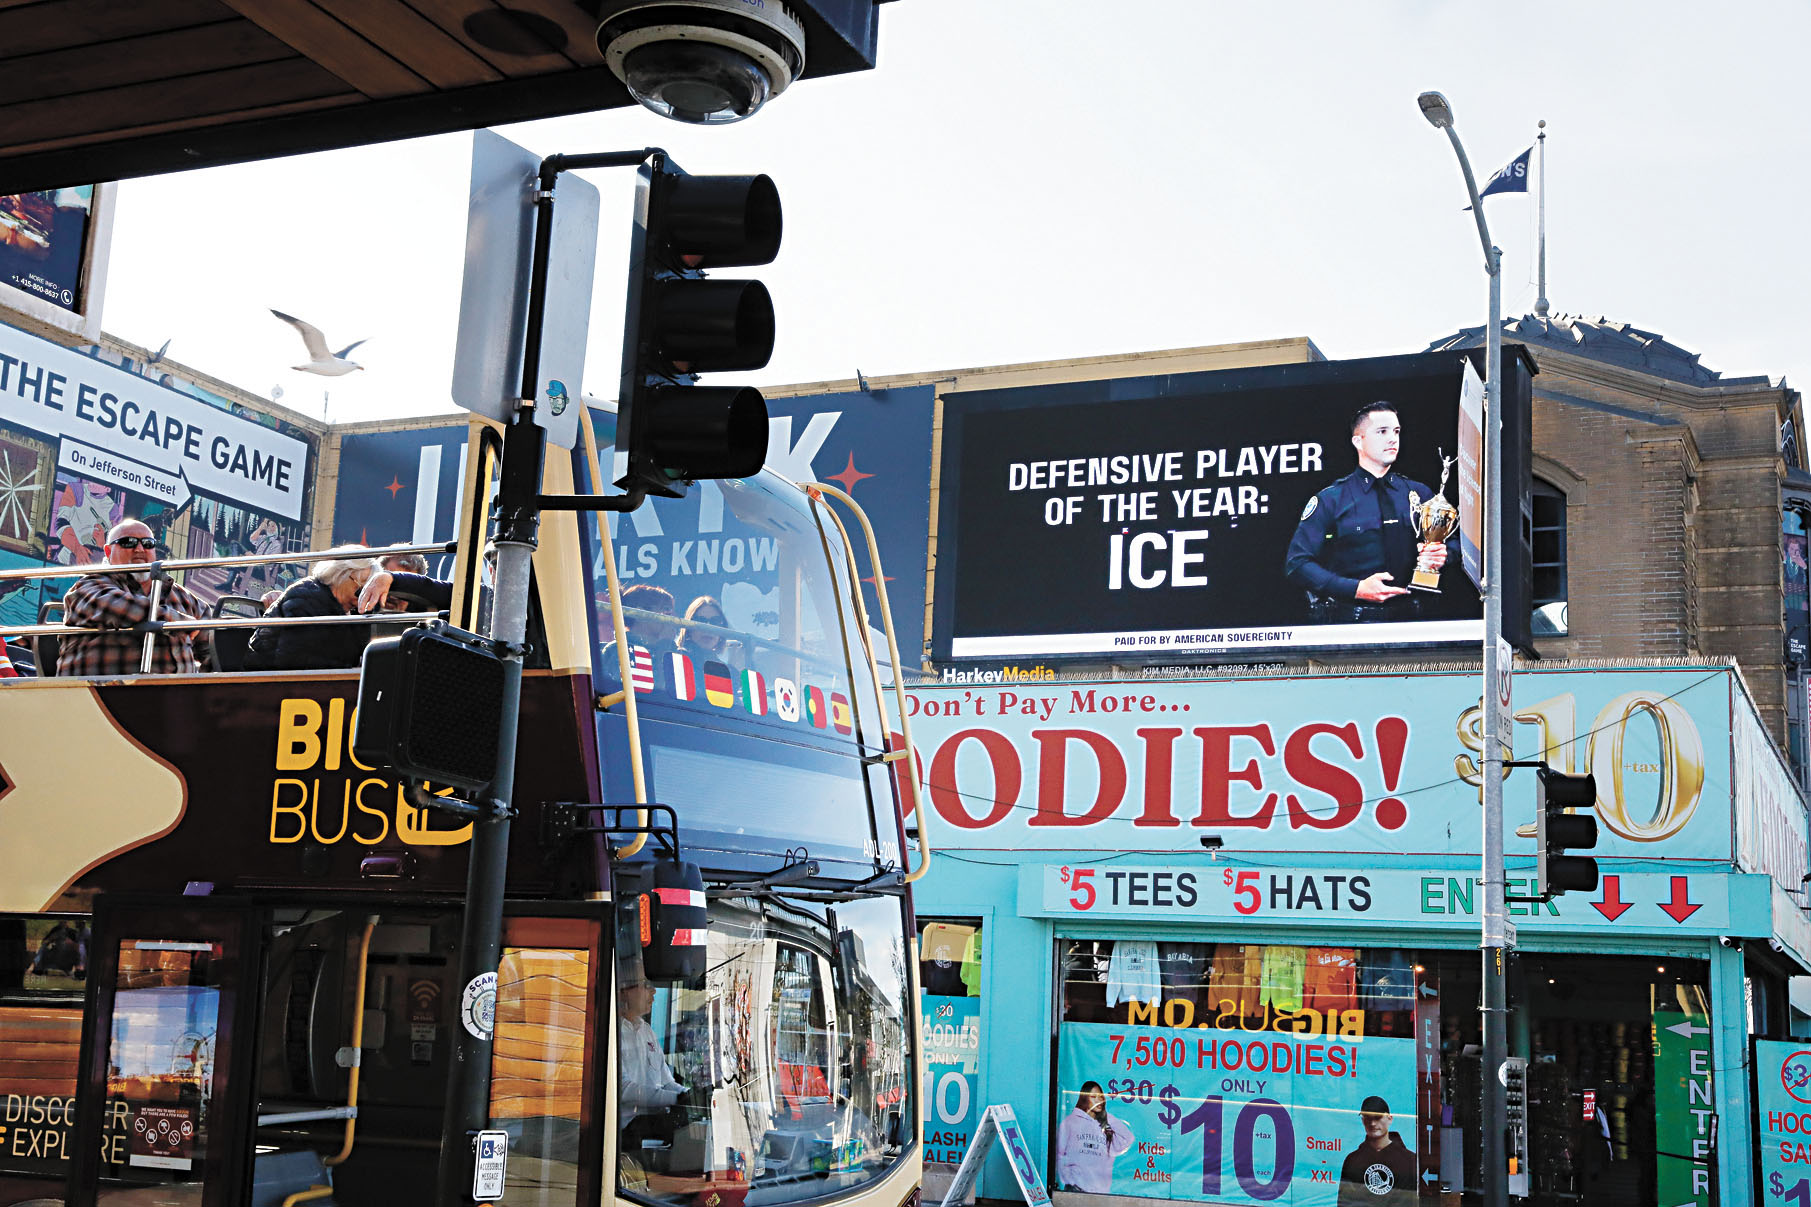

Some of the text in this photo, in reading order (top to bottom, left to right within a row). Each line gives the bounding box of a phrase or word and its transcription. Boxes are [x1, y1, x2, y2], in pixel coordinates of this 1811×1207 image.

[29, 273, 44, 285] MORE
[0, 352, 293, 493] THE ESCAPE GAME
[71, 449, 177, 497] On Jefferson Street
[1008, 441, 1324, 491] DEFENSIVE PLAYER
[1044, 484, 1270, 526] OF THE YEAR:
[670, 537, 780, 577] KNOW
[1108, 529, 1209, 590] ICE
[1114, 631, 1293, 646] PAID FOR BY AMERICAN SOVEREIGNTY
[1143, 666, 1159, 675] KIM
[899, 689, 1192, 721] Don't Pay More...
[275, 697, 377, 771] BI
[1623, 761, 1660, 774] +tax
[269, 778, 389, 845] BUS
[1060, 866, 1560, 917] $5 TEES $5 HATS ENER
[469, 975, 494, 993] SCAN
[925, 1052, 961, 1066] ONLY
[1109, 1034, 1359, 1079] 7,500 HOODIES!
[1784, 1063, 1811, 1088] $3
[1107, 1078, 1155, 1105] $30
[1221, 1078, 1267, 1095] ONLY
[1424, 1019, 1434, 1155] EXIT
[1137, 1141, 1166, 1156] Kids
[1306, 1136, 1341, 1152] Small
[1780, 1141, 1811, 1165] SA
[480, 1162, 503, 1171] ACCESSIBLE
[1146, 1157, 1156, 1169] &
[481, 1172, 499, 1181] MESSAGE
[483, 1181, 495, 1191] ONLY
[1133, 1168, 1172, 1183] Adults
[1310, 1169, 1337, 1185] XXL
